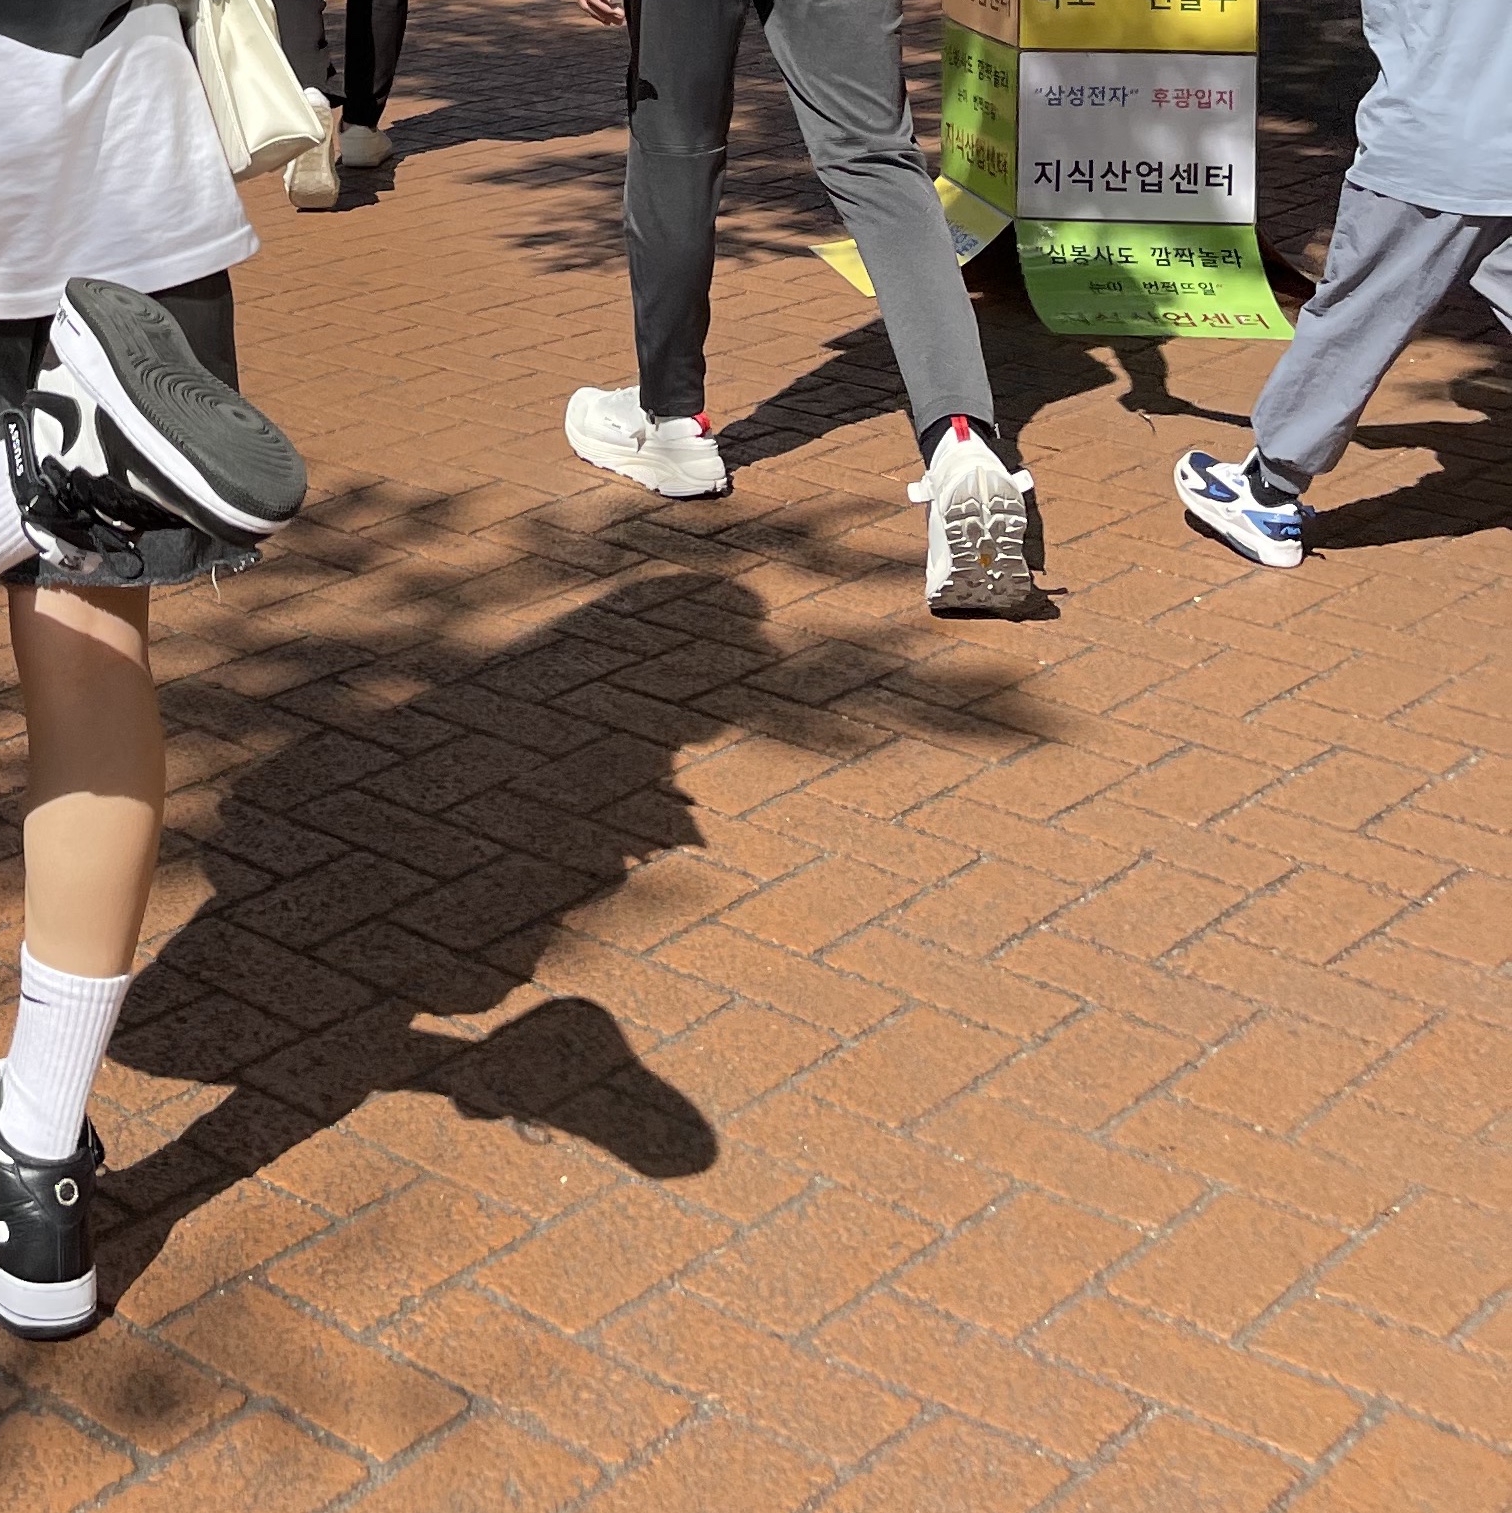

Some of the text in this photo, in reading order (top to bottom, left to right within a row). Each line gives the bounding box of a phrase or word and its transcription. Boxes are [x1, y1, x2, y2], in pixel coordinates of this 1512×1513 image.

[1151, 88, 1234, 111] 후광입지
[1034, 159, 1234, 196] 지식산업센터
[1150, 246, 1242, 268] 깜짝놀라
[8, 422, 24, 477] STUSSY
